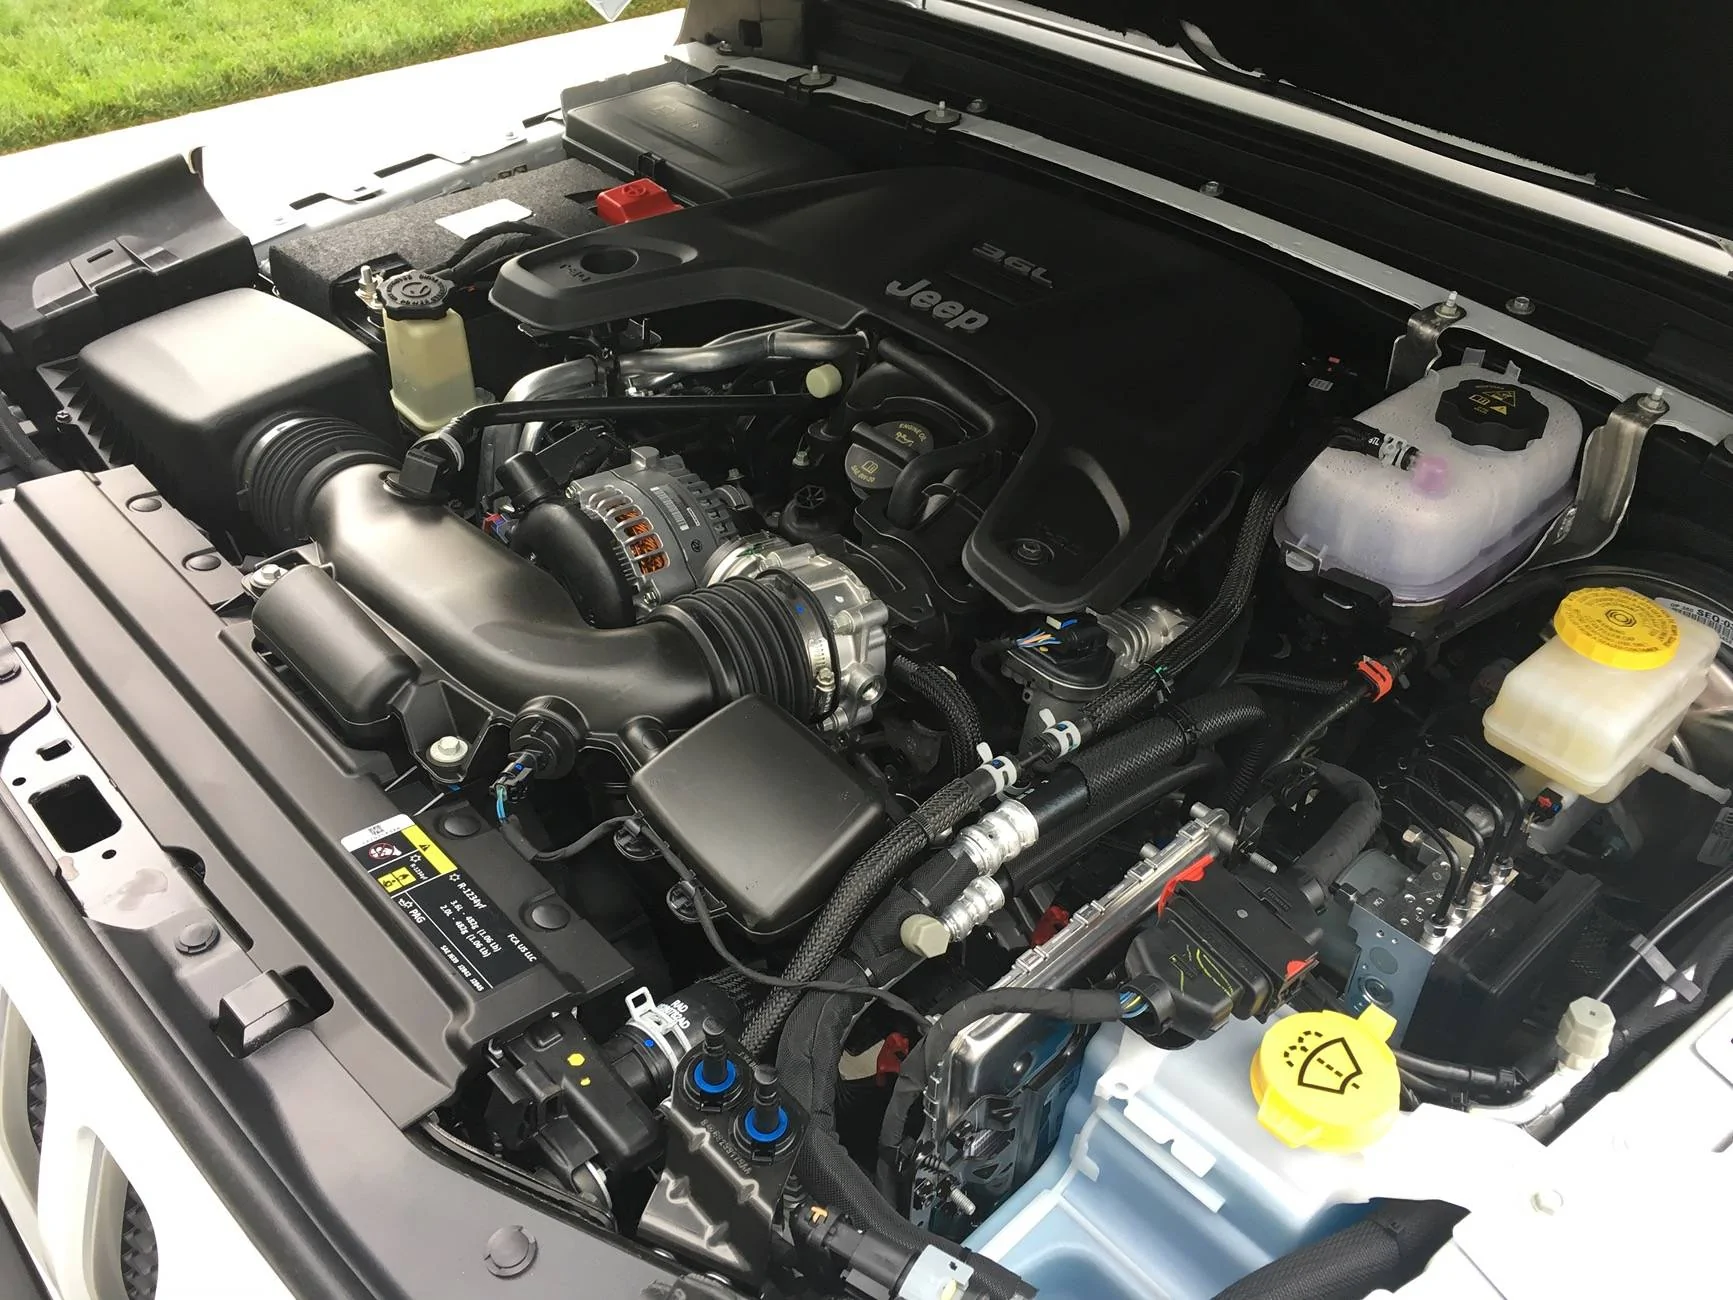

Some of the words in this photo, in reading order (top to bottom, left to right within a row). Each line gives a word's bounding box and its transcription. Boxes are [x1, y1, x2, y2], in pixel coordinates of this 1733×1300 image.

[885, 279, 989, 333] Jeep
[457, 882, 487, 910] R-1234yf
[409, 907, 426, 924] PAG
[465, 915, 480, 930] 482g
[455, 920, 470, 936] 482g
[507, 933, 520, 947] FCA
[518, 944, 527, 954] US
[525, 951, 537, 962] LLC
[671, 999, 689, 1012] RAD
